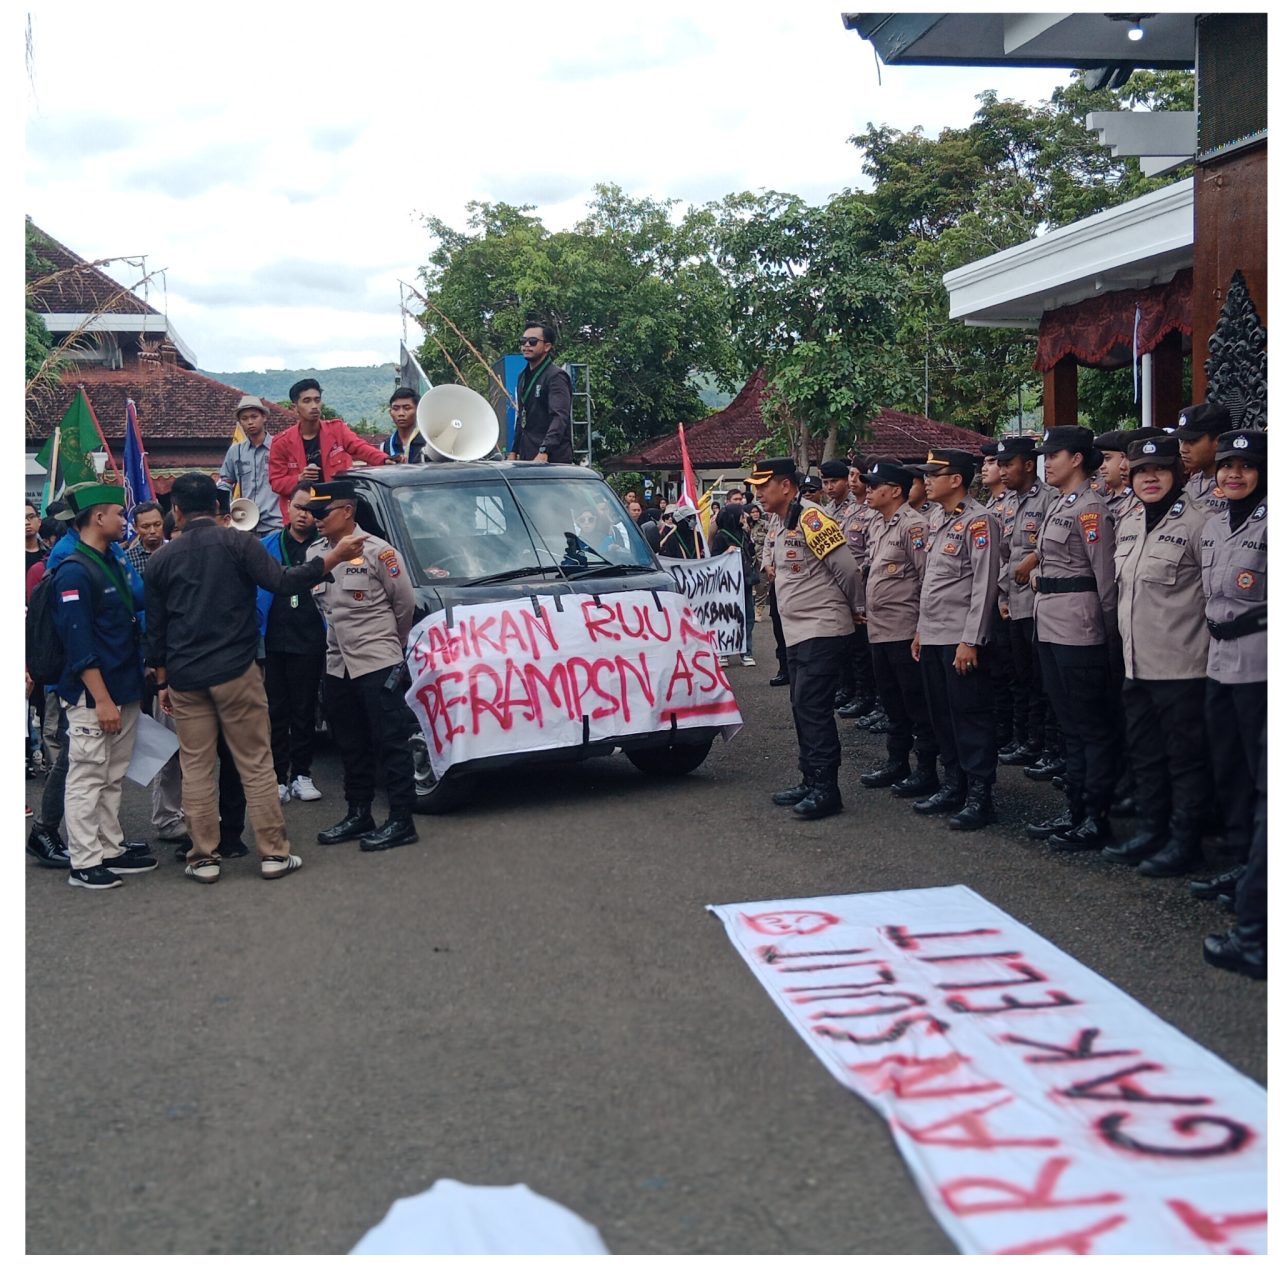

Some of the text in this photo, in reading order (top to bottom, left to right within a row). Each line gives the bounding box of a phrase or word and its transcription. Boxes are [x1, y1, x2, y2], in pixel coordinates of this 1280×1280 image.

[1052, 517, 1072, 528] POLRI
[1158, 534, 1187, 546] POLRI
[1241, 540, 1267, 552] POLR
[414, 604, 559, 668] SAHKAN
[757, 943, 953, 1046] SULIT
[876, 921, 1085, 1016] ELIT
[1001, 1025, 1256, 1160] GAK
